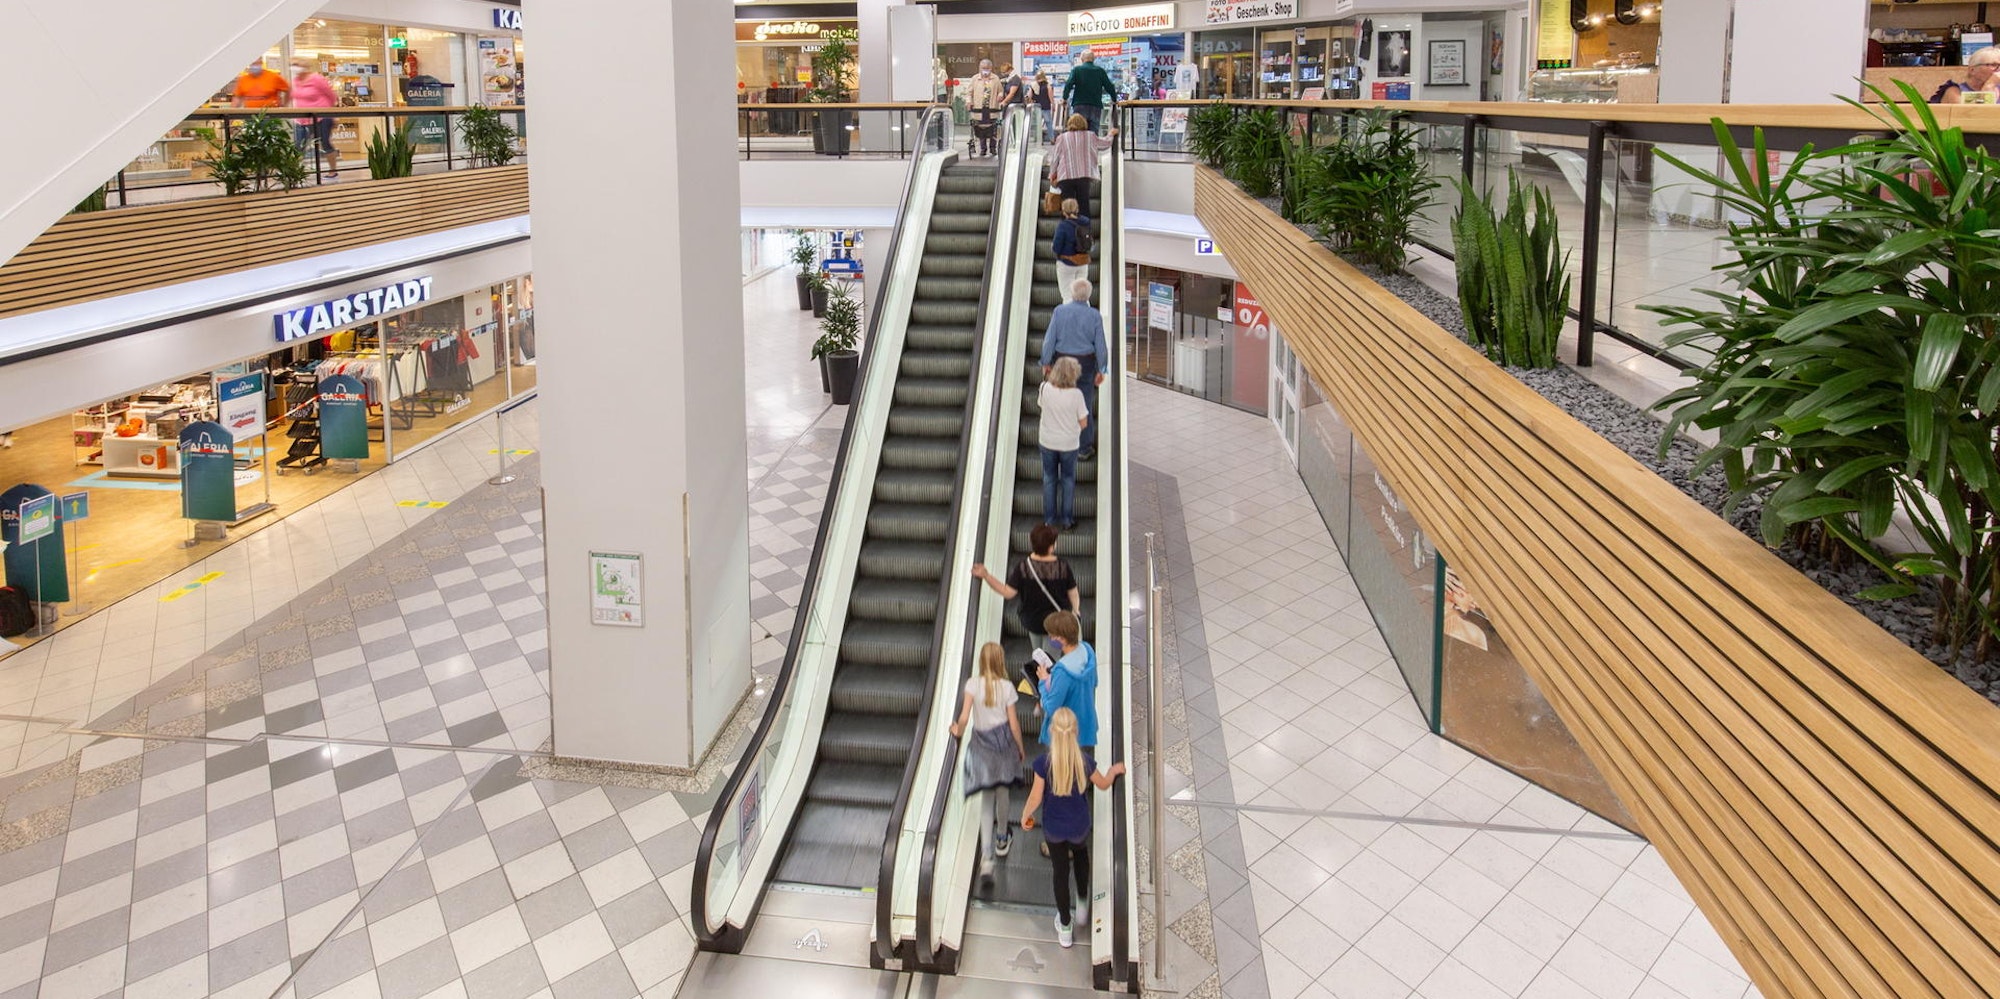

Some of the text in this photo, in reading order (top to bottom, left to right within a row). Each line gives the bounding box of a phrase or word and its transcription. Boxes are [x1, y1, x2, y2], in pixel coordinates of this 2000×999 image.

[1236, 4, 1269, 19] Geschenk
[1274, 2, 1292, 18] Shop
[1070, 14, 1169, 33] RING FOTO BONAFFINI
[1024, 41, 1068, 53] Passbilder
[1155, 55, 1181, 66] XXL-
[1200, 241, 1211, 252] P
[282, 275, 433, 342] KARSTADT
[230, 383, 255, 394] GALERIA
[321, 392, 362, 401] GALERIA
[229, 408, 257, 421] Eingang
[190, 442, 230, 453] ALERIA
